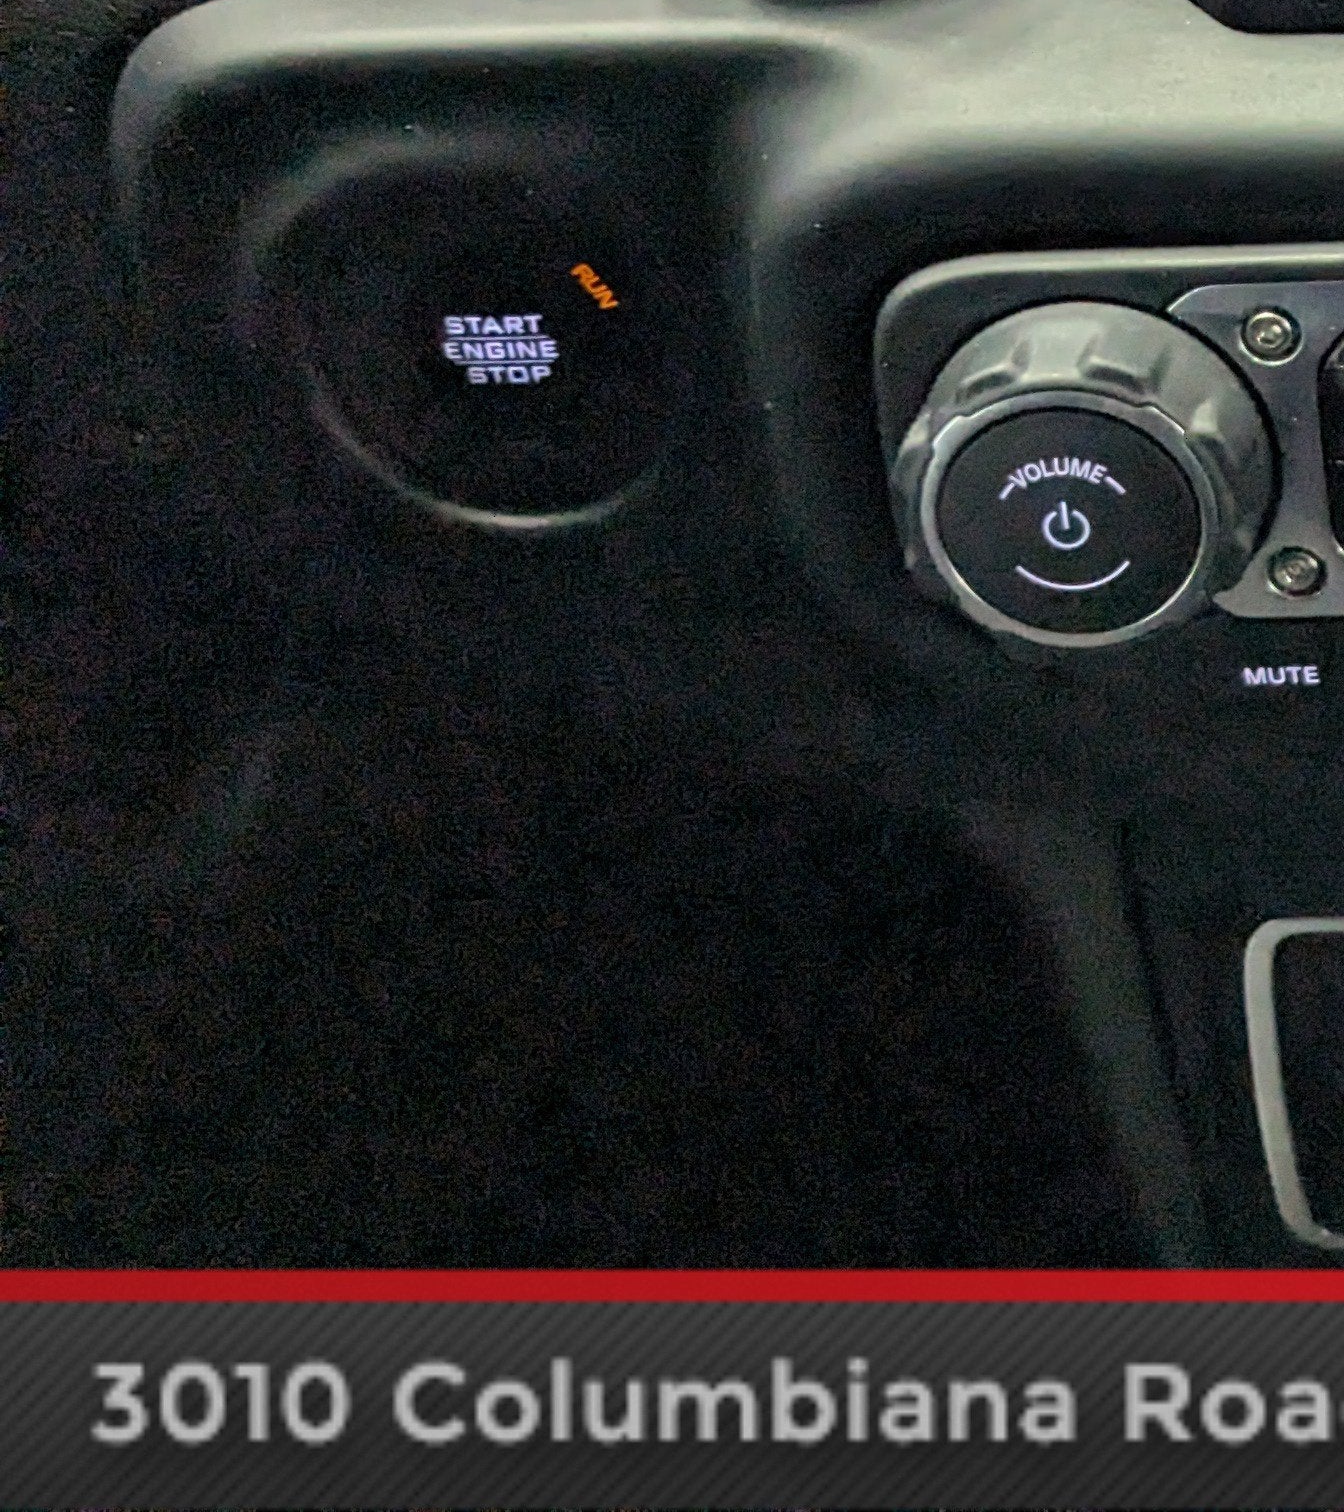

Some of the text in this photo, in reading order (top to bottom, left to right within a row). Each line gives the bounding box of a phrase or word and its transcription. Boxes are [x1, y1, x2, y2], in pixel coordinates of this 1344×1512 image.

[571, 263, 618, 309] RUN
[443, 314, 544, 336] START
[442, 340, 560, 361] ENGINE
[467, 365, 552, 385] STOP
[1009, 457, 1108, 491] VOLUME
[1243, 665, 1321, 686] MUTE
